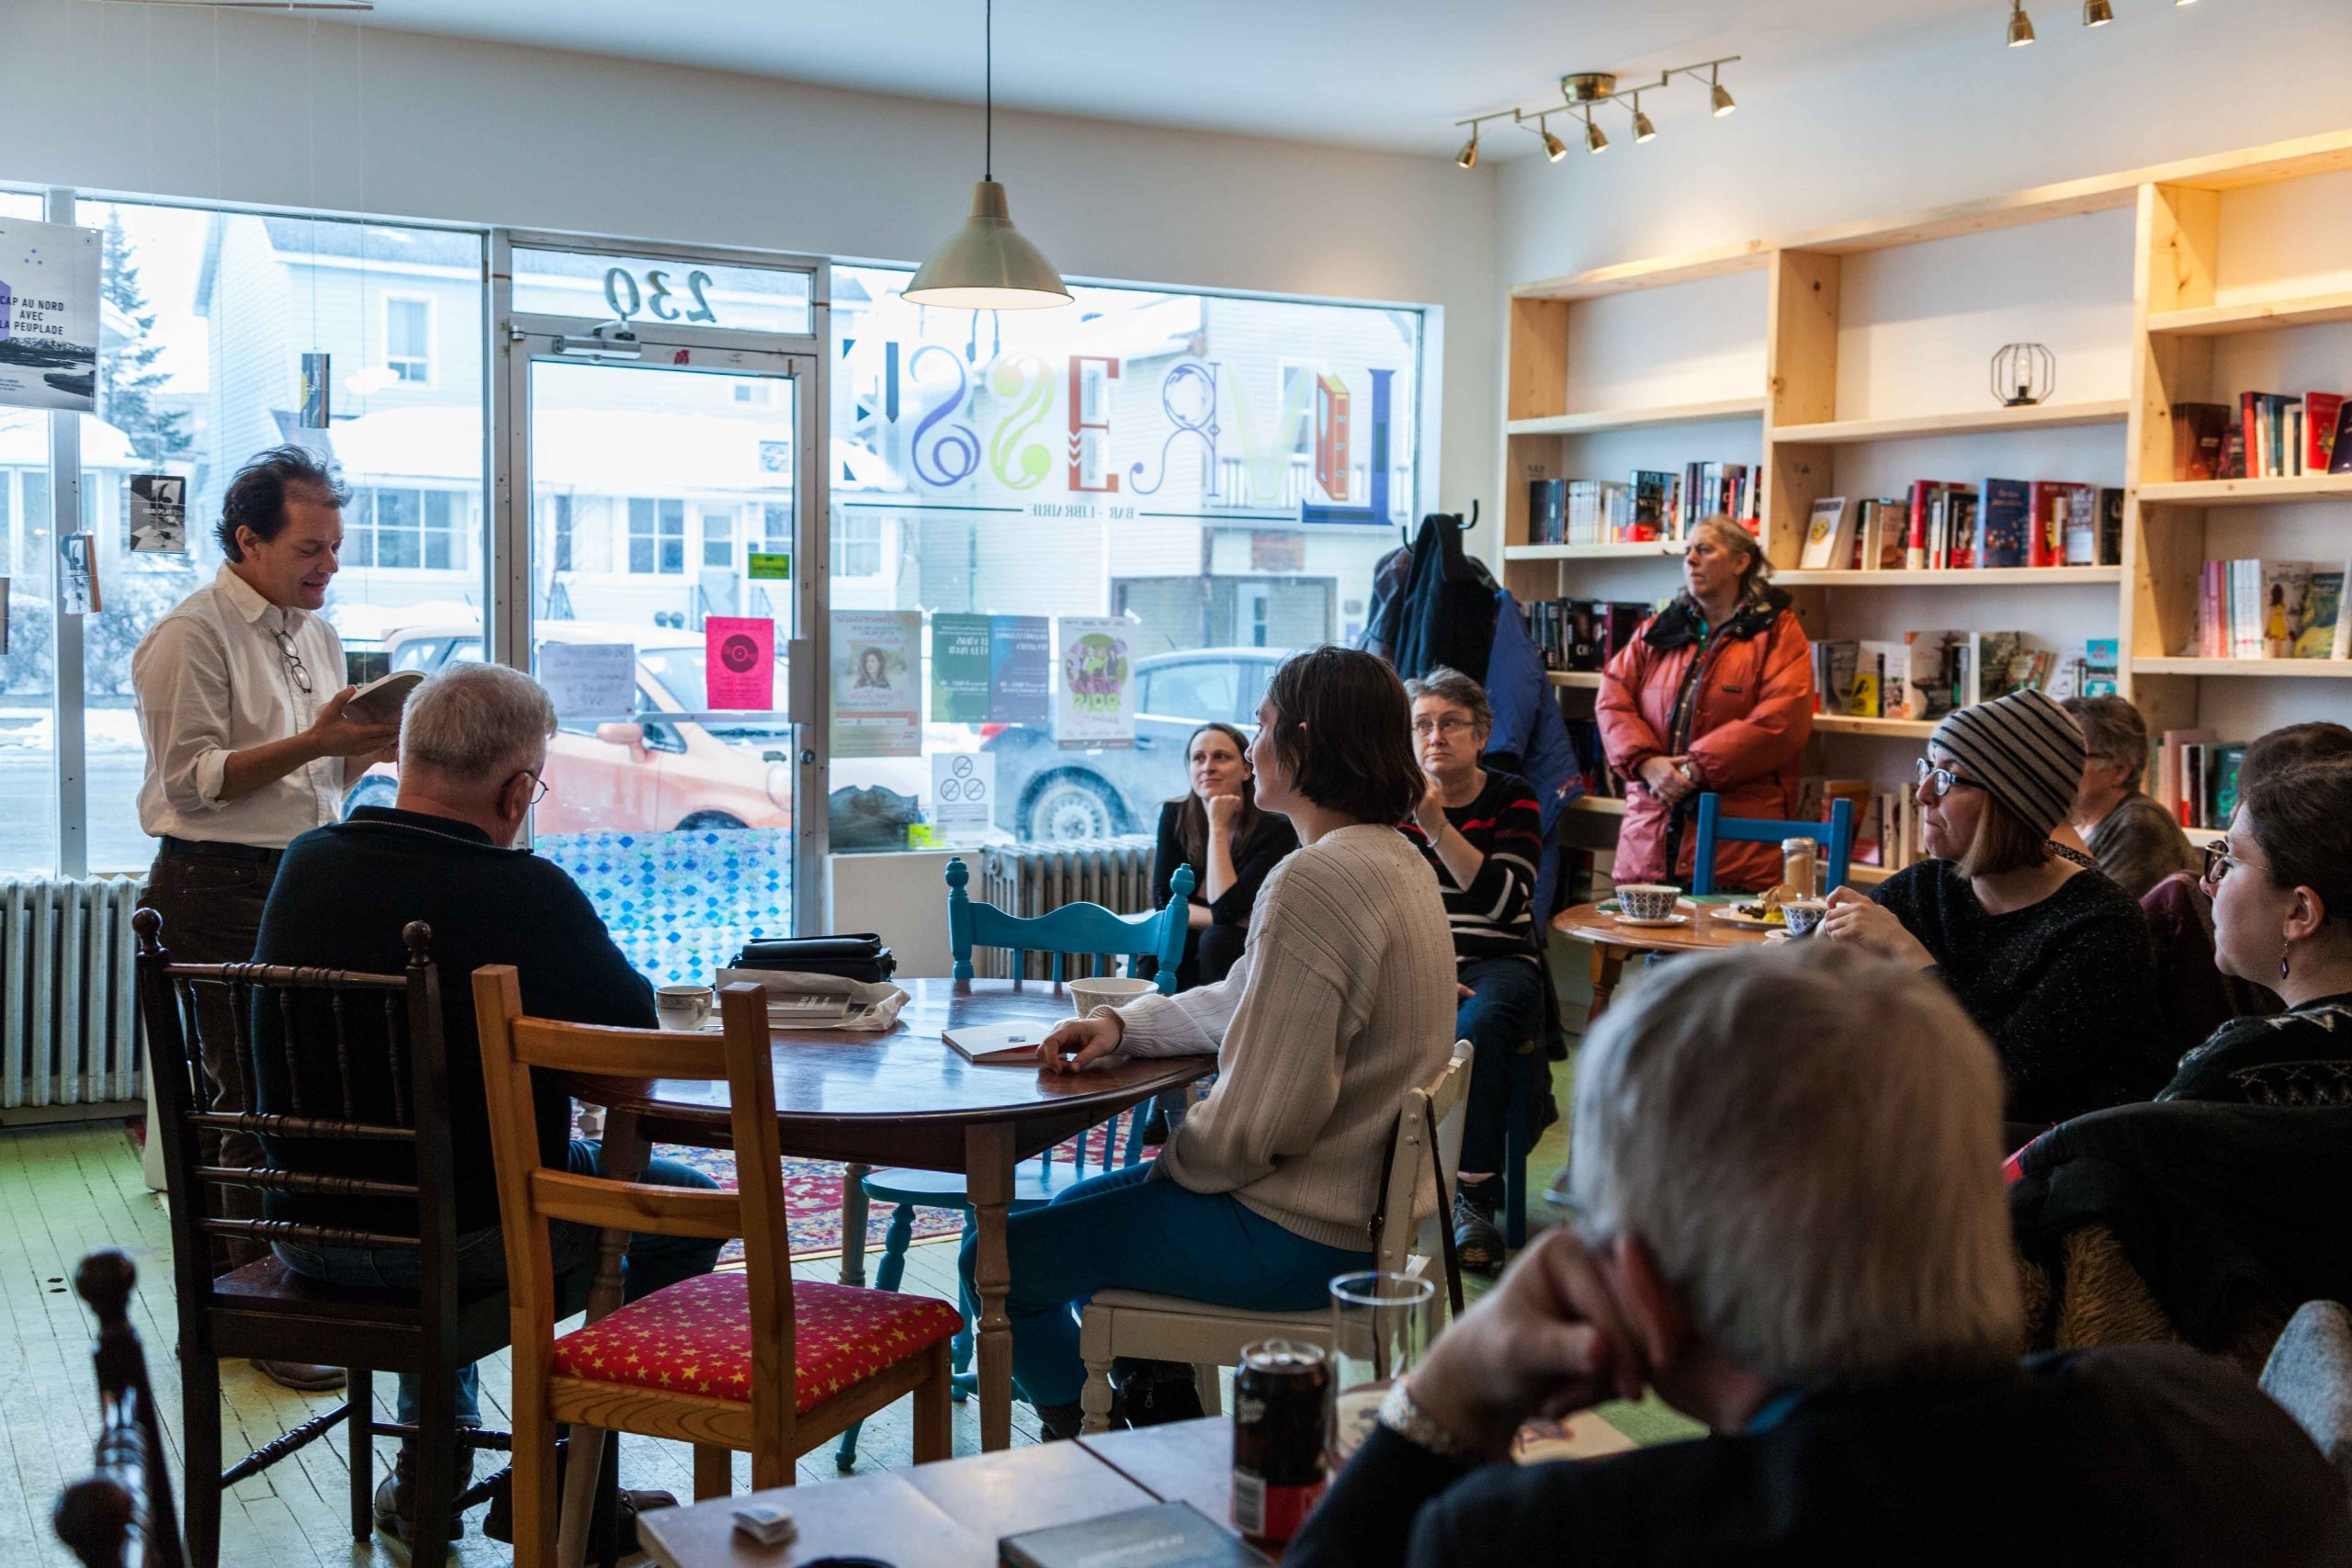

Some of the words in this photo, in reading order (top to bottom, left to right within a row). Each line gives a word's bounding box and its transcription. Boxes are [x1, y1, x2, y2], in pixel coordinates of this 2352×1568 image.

[0, 295, 18, 308] CAP
[21, 298, 35, 310] AU
[38, 299, 64, 312] NORD
[19, 309, 44, 322] AVEC
[0, 319, 10, 331] LA
[14, 321, 64, 336] PEUPLADE
